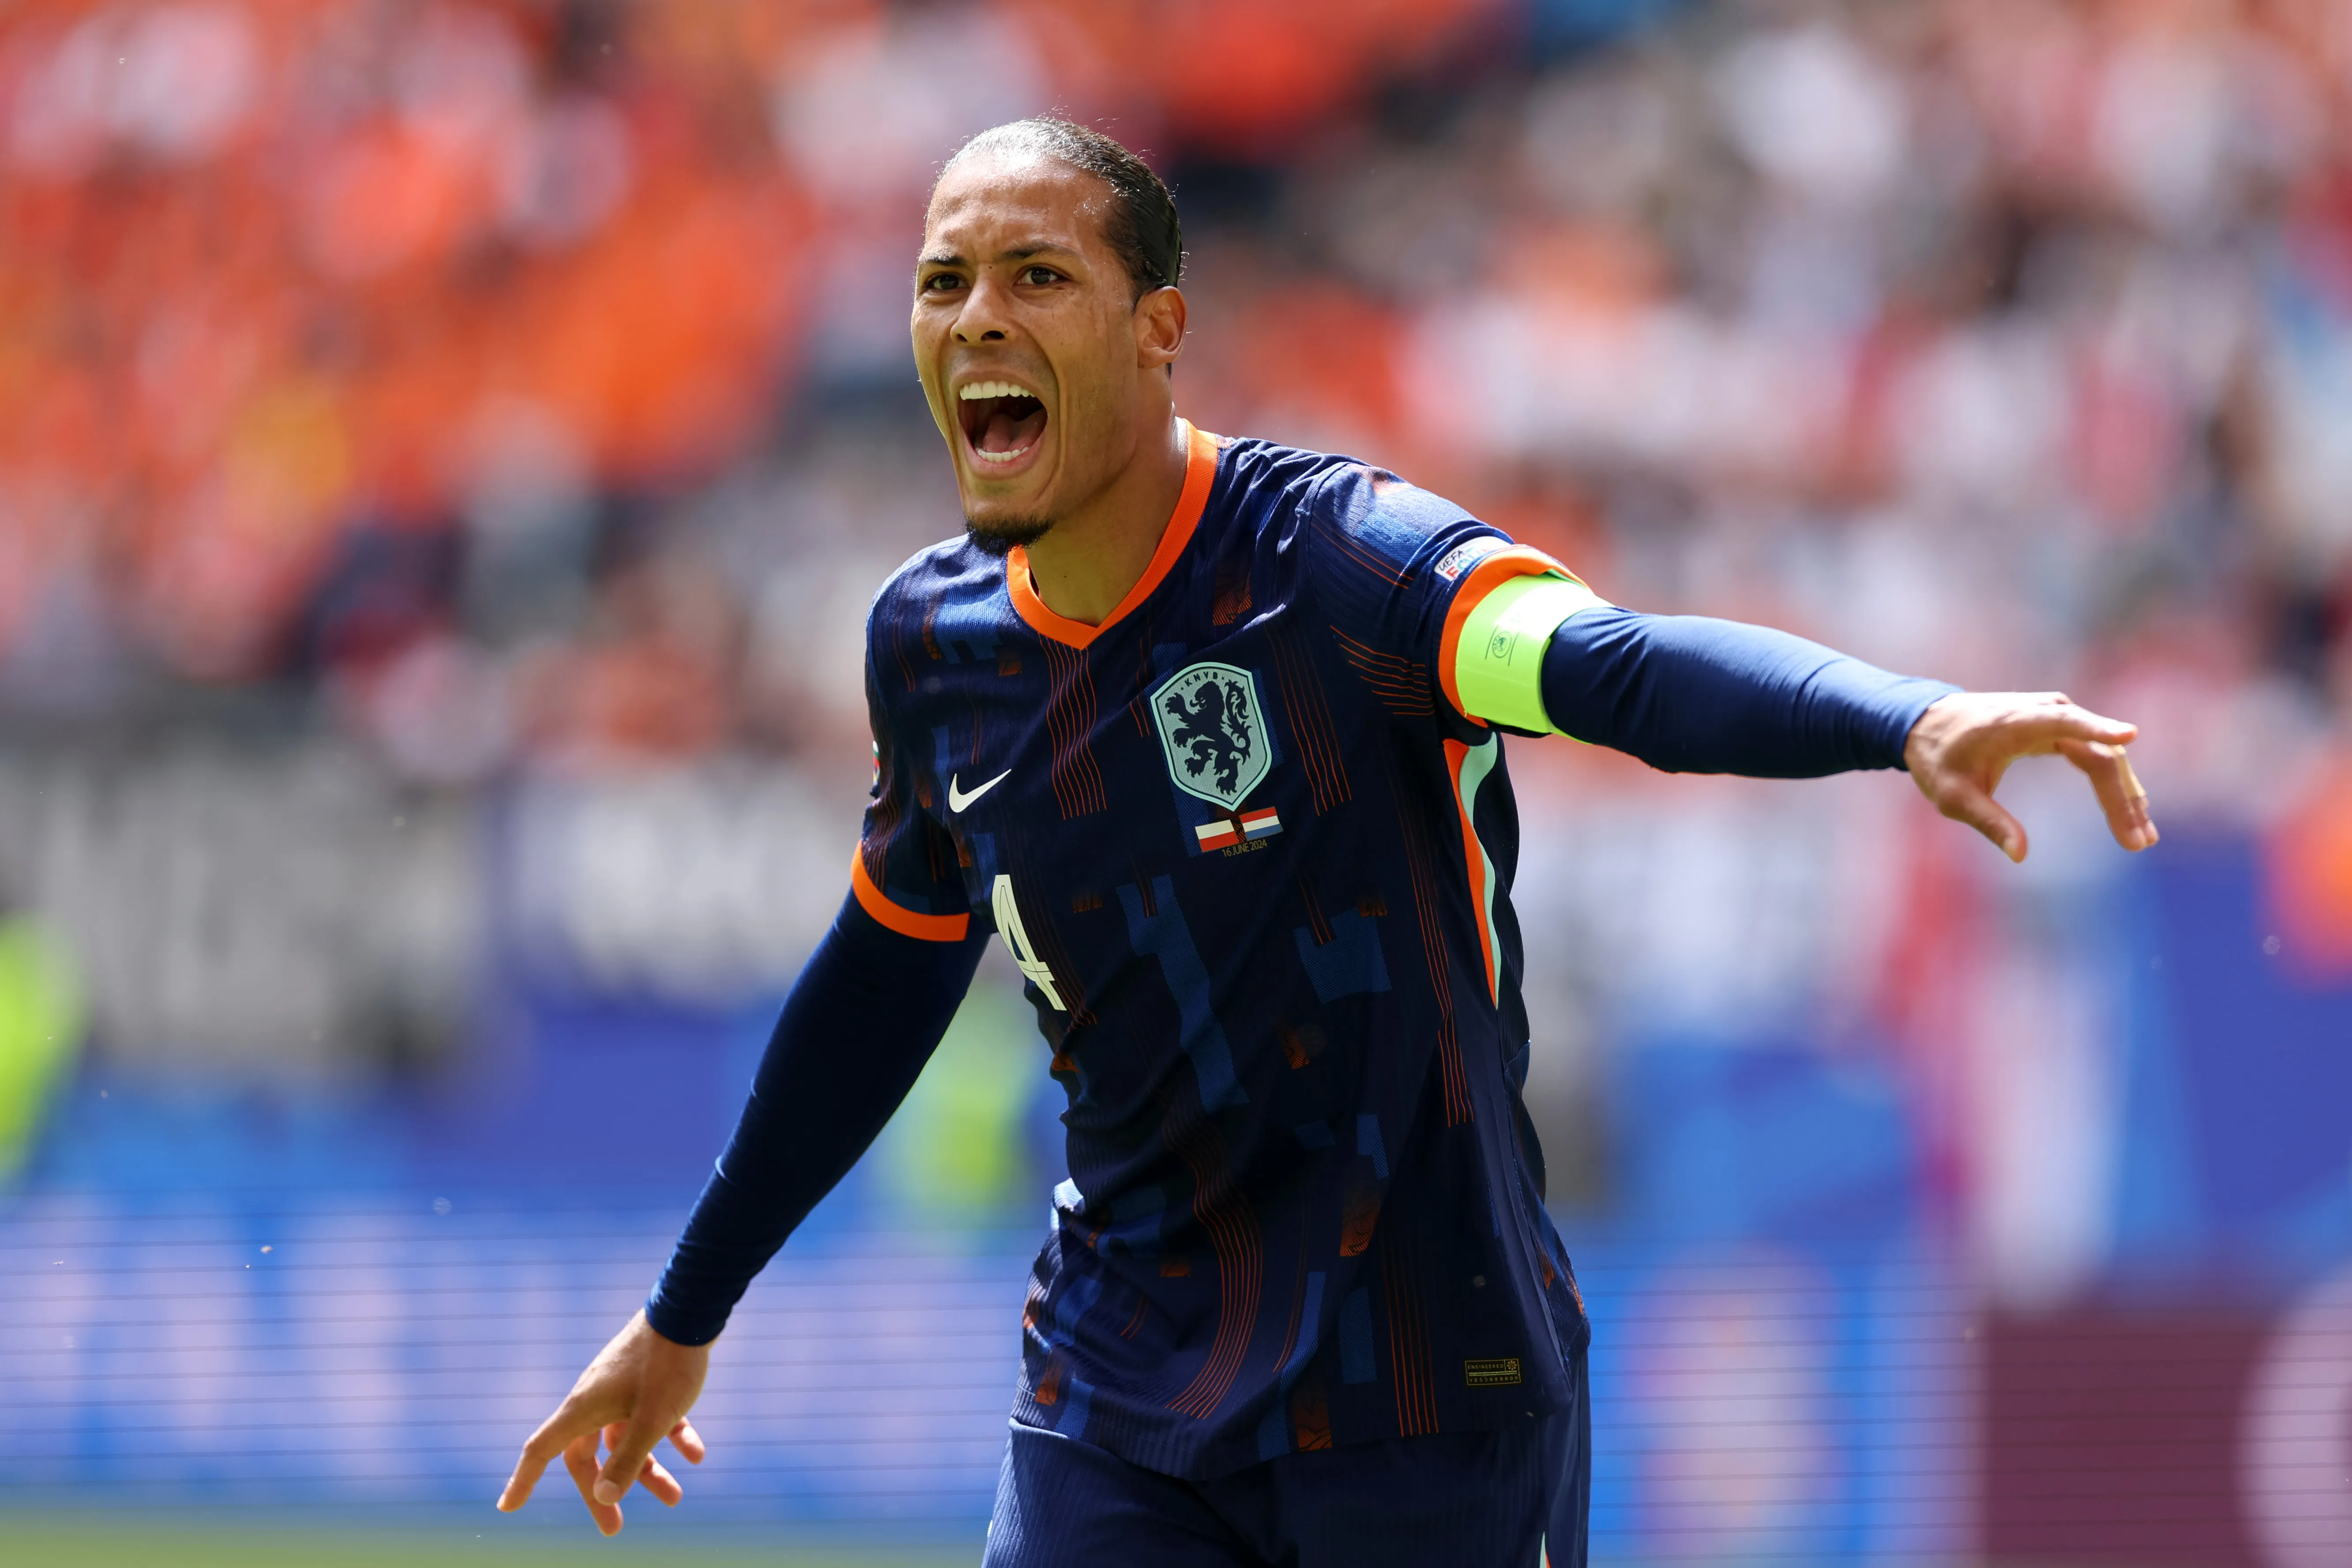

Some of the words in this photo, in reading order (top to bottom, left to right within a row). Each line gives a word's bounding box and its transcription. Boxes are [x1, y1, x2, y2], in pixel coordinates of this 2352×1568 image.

[1439, 550, 1464, 571] UEFA
[1222, 848, 1232, 857] 16
[1232, 843, 1250, 855] JUNE
[1250, 839, 1267, 851] 2024
[992, 874, 1067, 1011] 4
